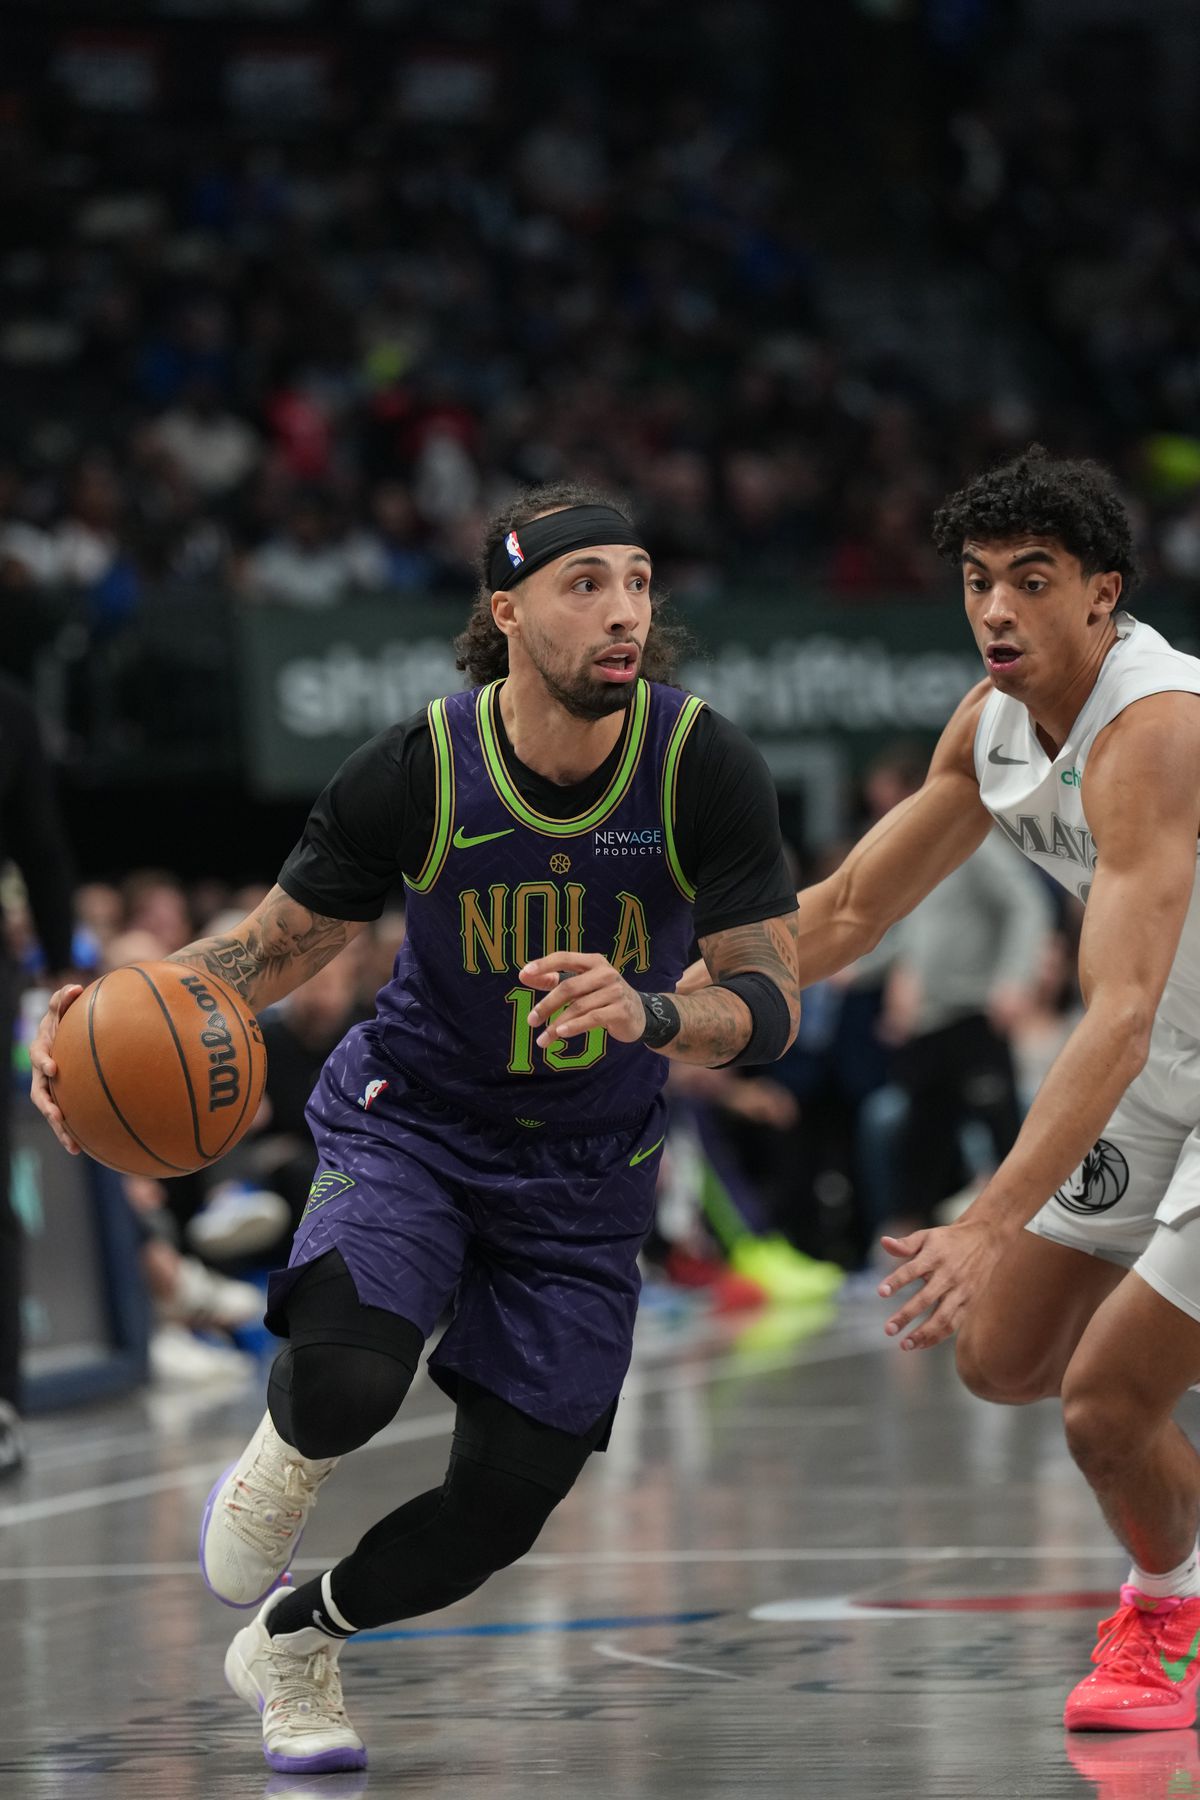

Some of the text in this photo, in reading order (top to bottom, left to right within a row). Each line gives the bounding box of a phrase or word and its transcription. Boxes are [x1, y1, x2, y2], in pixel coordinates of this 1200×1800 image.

[595, 830, 662, 845] NEWAGE
[595, 846, 662, 856] PRODUCTS
[459, 881, 651, 975] NOLA
